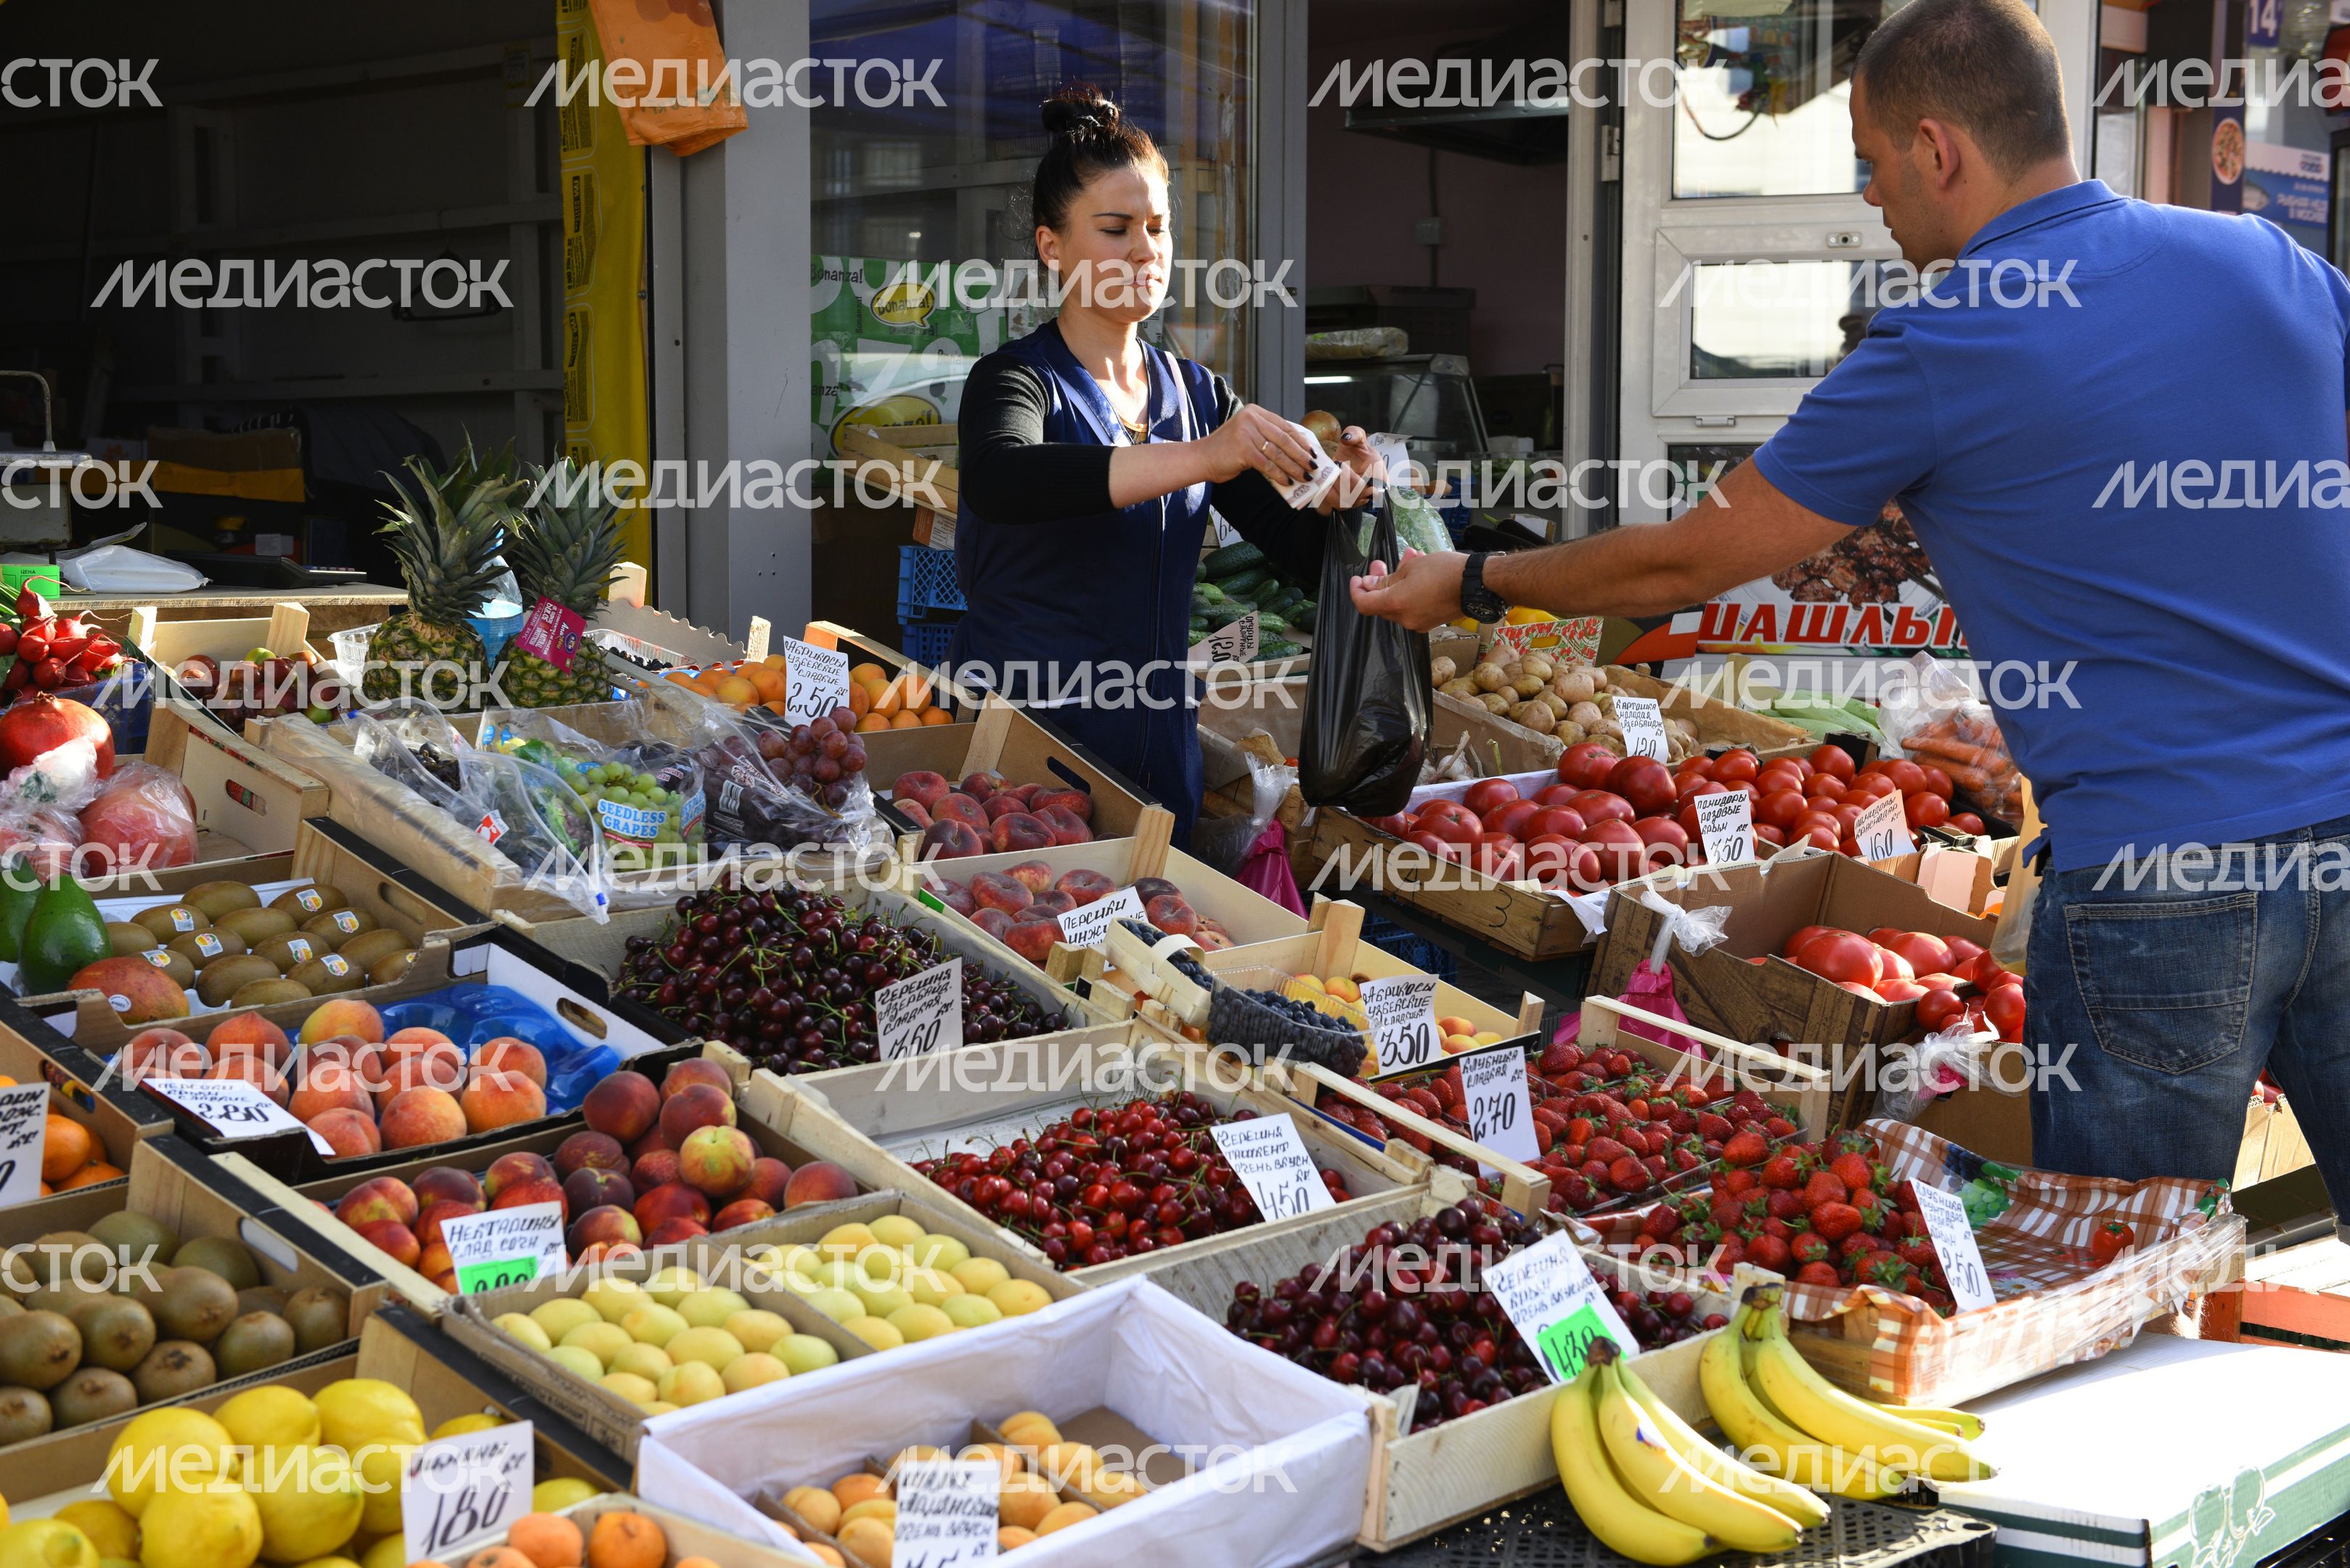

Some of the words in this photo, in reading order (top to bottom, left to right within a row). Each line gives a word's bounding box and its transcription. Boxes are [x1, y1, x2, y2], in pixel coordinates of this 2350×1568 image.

[878, 295, 930, 315] Bonanza!
[523, 626, 531, 640] ВКУС
[1699, 603, 1967, 646] ШАШЛЫ
[785, 640, 846, 669] АБРИКОСЫ
[786, 682, 839, 718] 250
[1616, 699, 1657, 711] КАРТОШКА
[600, 801, 666, 823] SEEDLESS
[1697, 794, 1747, 809] ПОМИДОРЫ
[1701, 805, 1741, 824] РОЗОВЫЕ
[1856, 796, 1896, 829] ПОМИДОРЫ
[604, 816, 658, 837] GRAPES
[1856, 804, 1898, 839] КРАСНОДАР
[1870, 828, 1893, 862] 160
[1064, 898, 1127, 931] ПЕРСИКИ
[878, 968, 952, 1005] ЧЕРЕШНЯ
[1363, 981, 1436, 1005] АБРИКОСЫ
[1368, 995, 1432, 1022] УЗБЕКСКИЕ
[1380, 1023, 1430, 1067] 350
[1462, 1050, 1518, 1074] КЛУБНИКА
[1466, 1063, 1508, 1088] СЛАДКАЯ
[1474, 1092, 1516, 1143] 270
[1217, 1126, 1283, 1147] ЧЕРЕШНЯ
[1225, 1142, 1289, 1160] ТАШКЕНТ
[1234, 1161, 1272, 1174] ОЧЕНЬ
[1257, 1181, 1310, 1220] 450
[449, 1214, 562, 1244] НЕКТАРИНЫ
[1491, 1247, 1569, 1293] ЧЕРЕШНЯ
[1943, 1247, 1980, 1298] 250
[421, 1481, 511, 1556] 180
